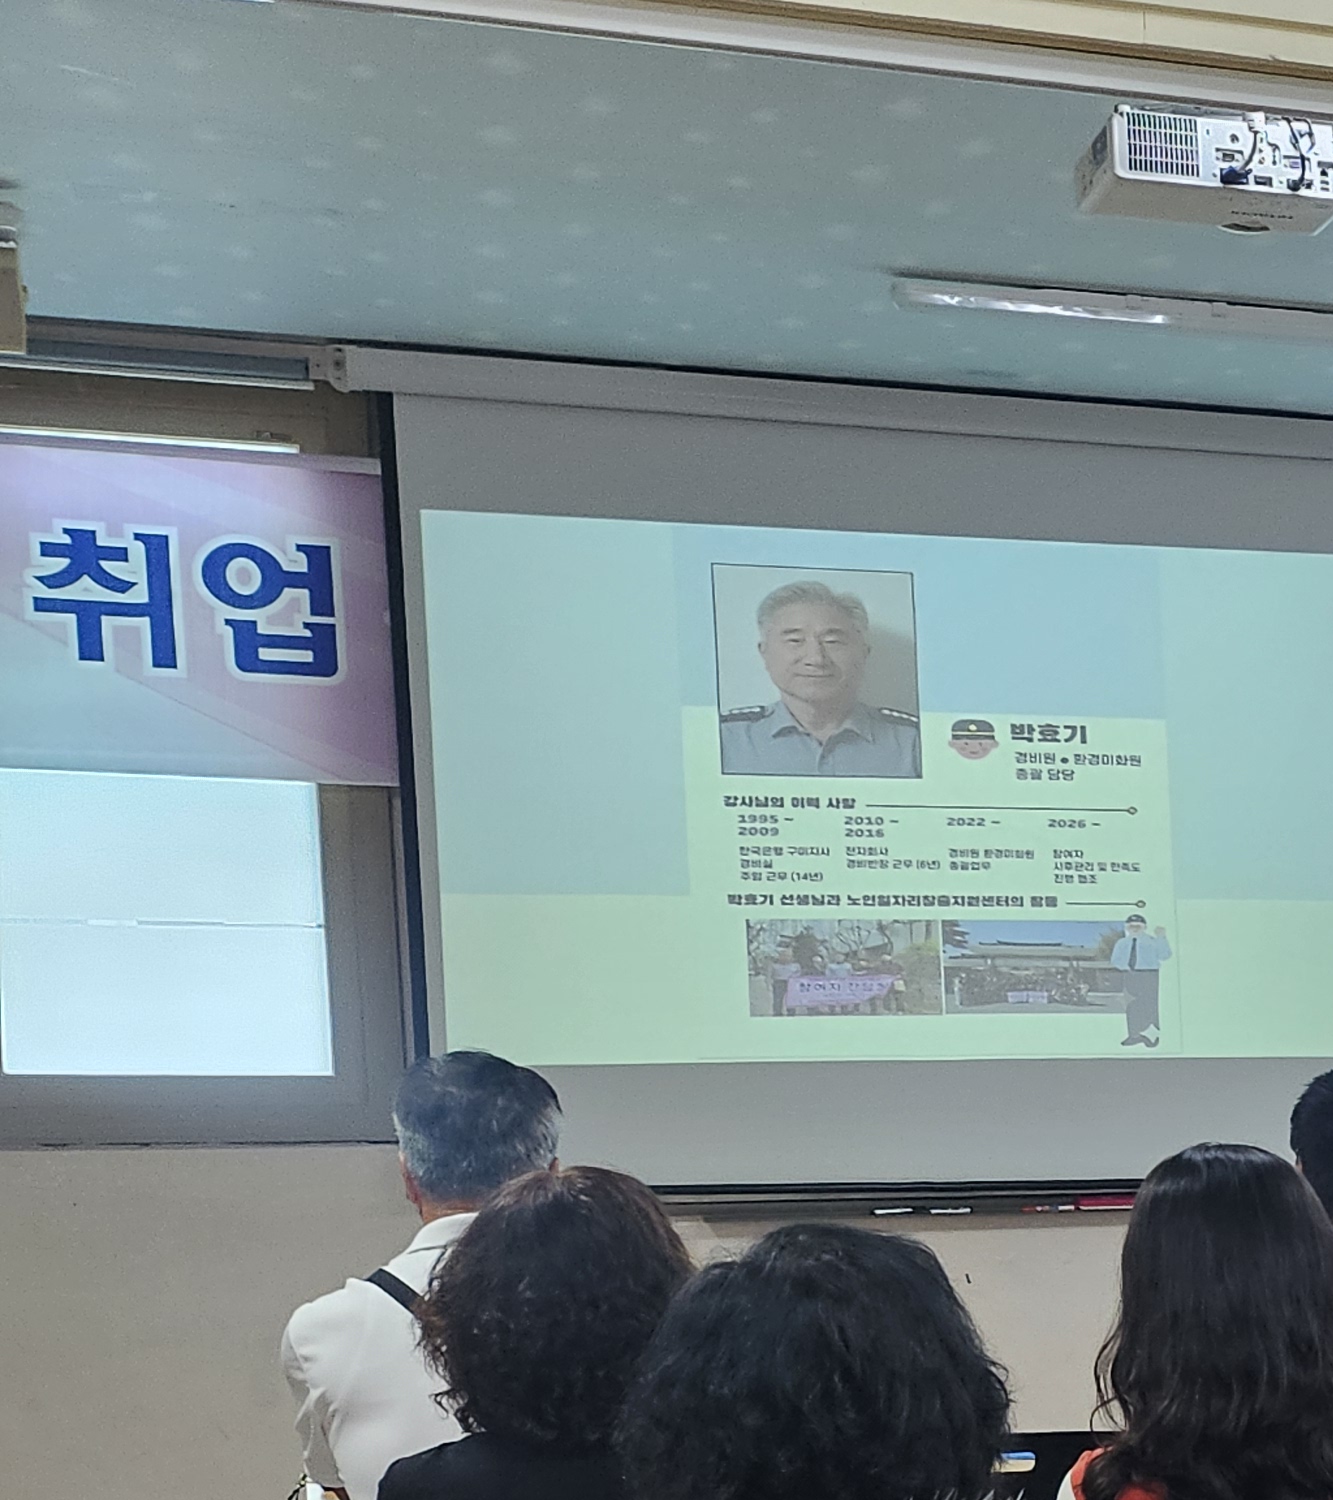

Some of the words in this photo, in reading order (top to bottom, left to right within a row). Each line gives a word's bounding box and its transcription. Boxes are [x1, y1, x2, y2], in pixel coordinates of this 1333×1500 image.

[29, 523, 343, 681] 취업
[1010, 723, 1087, 744] 박효기
[1014, 751, 1056, 765] 경비원
[1073, 753, 1142, 767] 환경미화원
[1047, 768, 1075, 781] 담당
[844, 816, 884, 826] 2010
[946, 817, 986, 827] 2022
[1047, 819, 1087, 829] 2026
[738, 826, 780, 837] 2009
